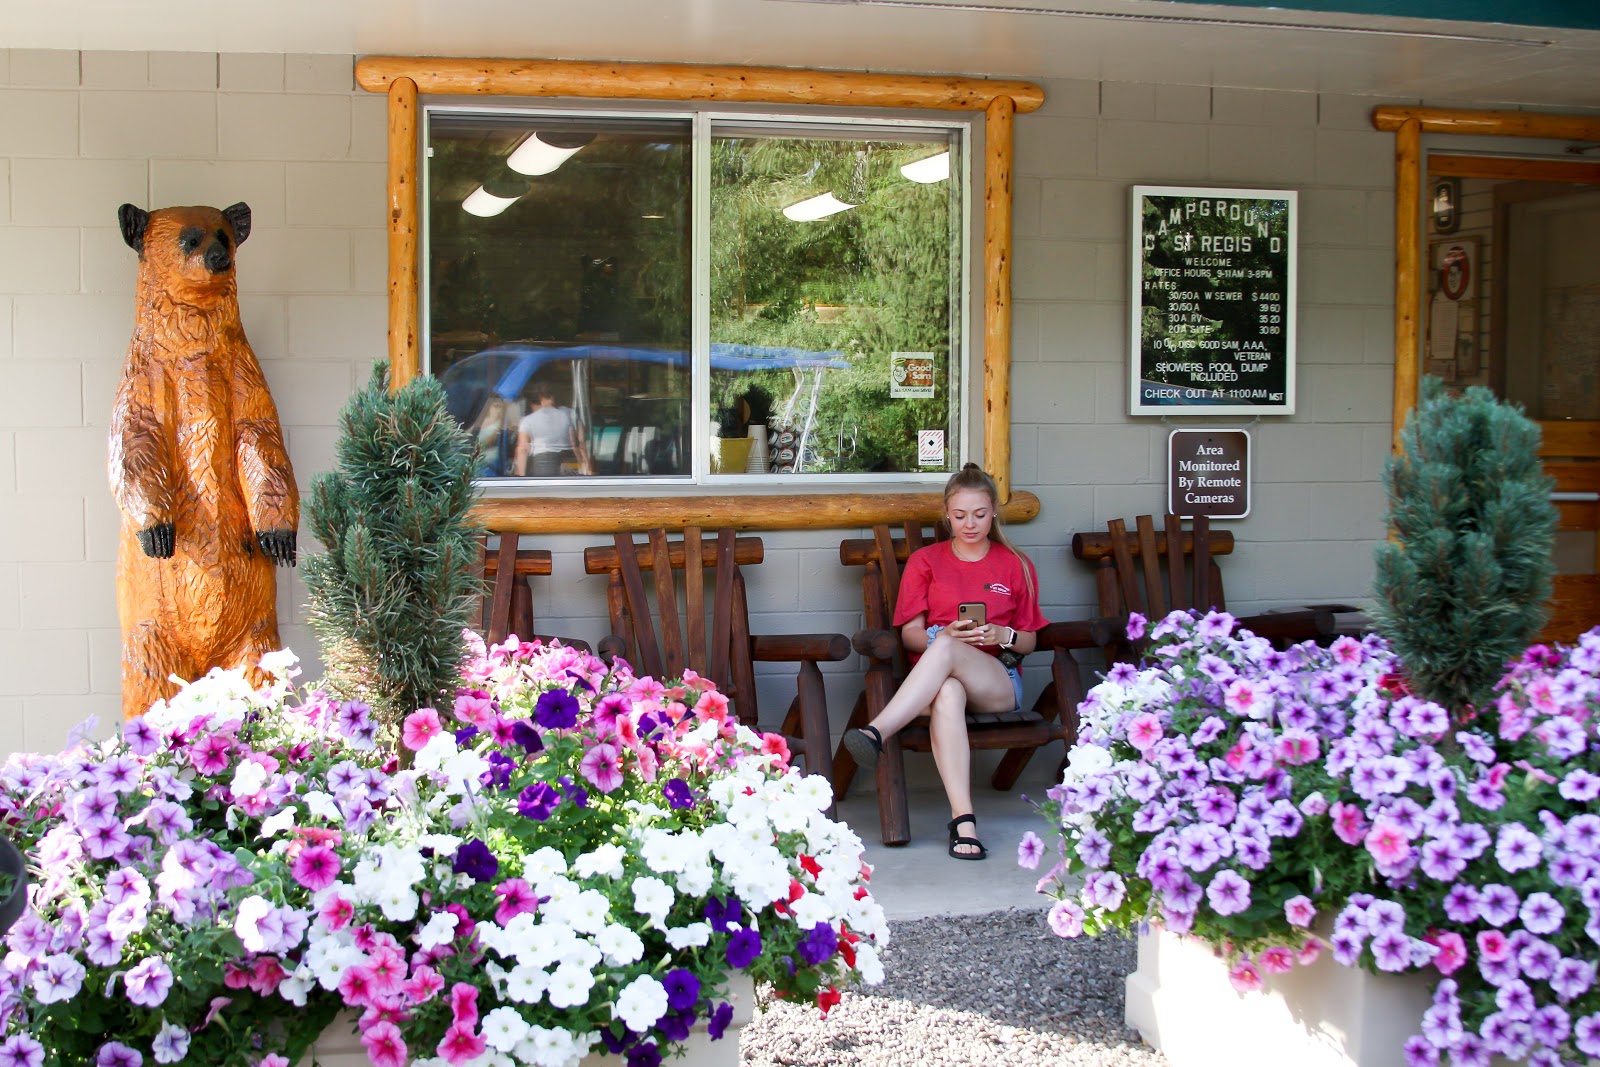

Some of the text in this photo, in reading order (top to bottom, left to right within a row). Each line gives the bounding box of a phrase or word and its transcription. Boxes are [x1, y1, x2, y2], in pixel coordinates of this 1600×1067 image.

[1201, 235, 1252, 252] REGIS
[1185, 257, 1232, 267] WELCOME
[1154, 268, 1273, 279] OFFICE HOURS 9-11AM 3-8PM
[1214, 292, 1243, 301] SEWER
[1191, 315, 1202, 323] RV
[1199, 341, 1220, 350] GOOD
[1234, 351, 1271, 361] VETERAN
[907, 363, 933, 372] Good
[1155, 362, 1269, 373] SHOWERS POOL DUMP
[912, 371, 932, 380] Sam
[1190, 372, 1239, 382] INCLUDED
[1144, 388, 1181, 399] CHECK
[1185, 389, 1206, 399] OUT
[1211, 389, 1226, 399] AT
[1268, 392, 1284, 401] MST
[1196, 444, 1224, 456] Area
[1179, 460, 1241, 472] Monitored
[1178, 476, 1242, 491] By Remote
[1184, 492, 1235, 504] Cameras
